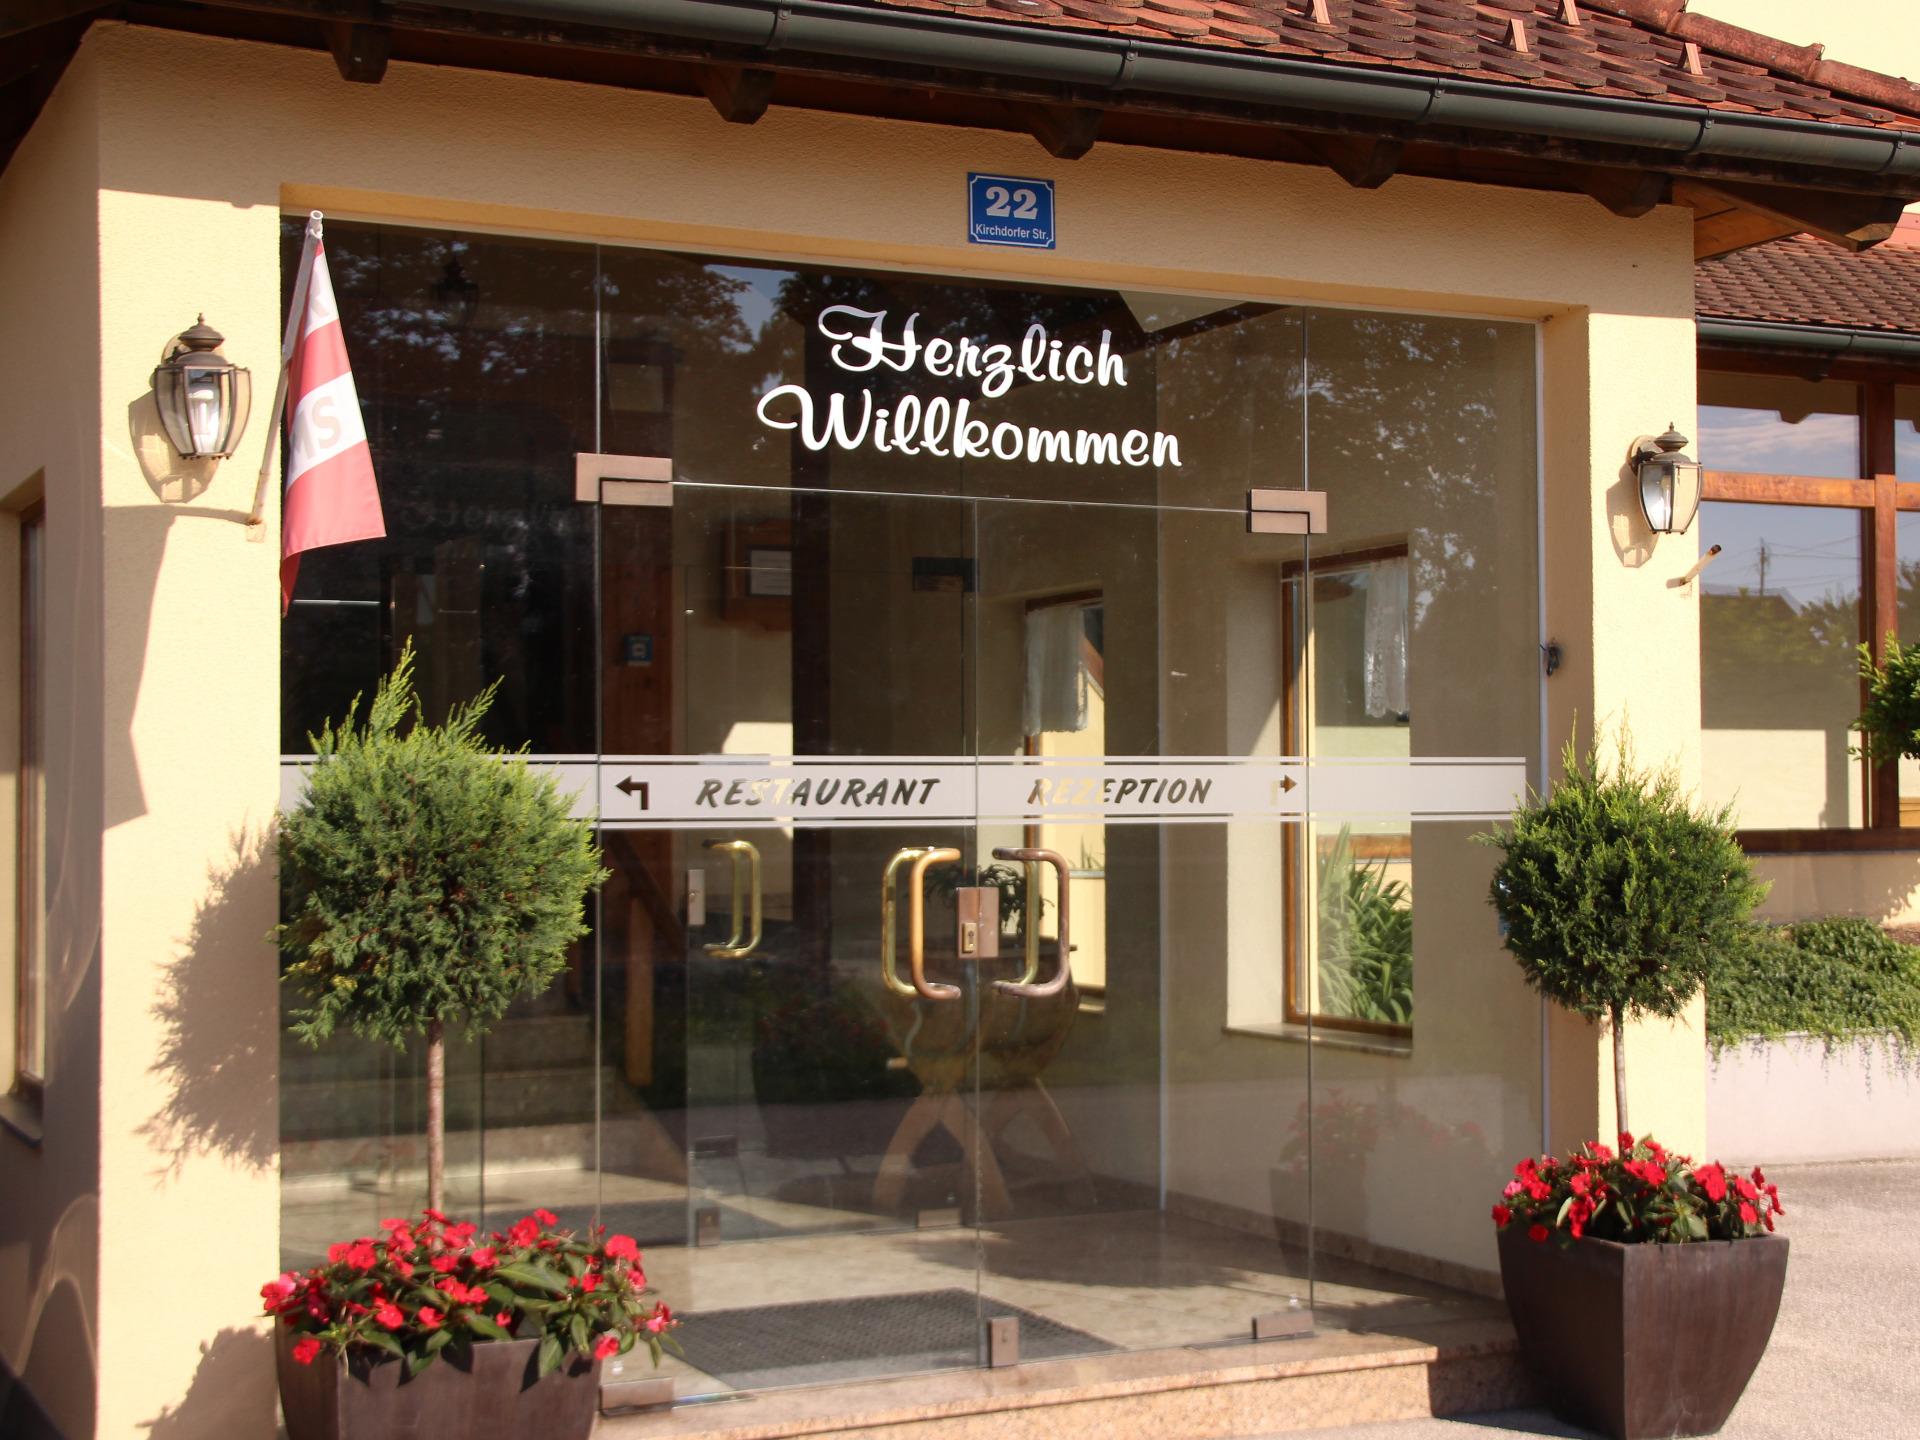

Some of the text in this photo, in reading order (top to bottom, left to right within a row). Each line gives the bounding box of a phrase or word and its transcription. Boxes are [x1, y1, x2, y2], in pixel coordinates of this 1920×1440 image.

[985, 186, 1038, 220] 22
[975, 223, 1049, 240] Kirchdorfer Str.
[818, 304, 1127, 398] Herzlich
[756, 384, 1182, 467] Willkommen
[695, 777, 1213, 808] RESTAURANT REZEPTION
